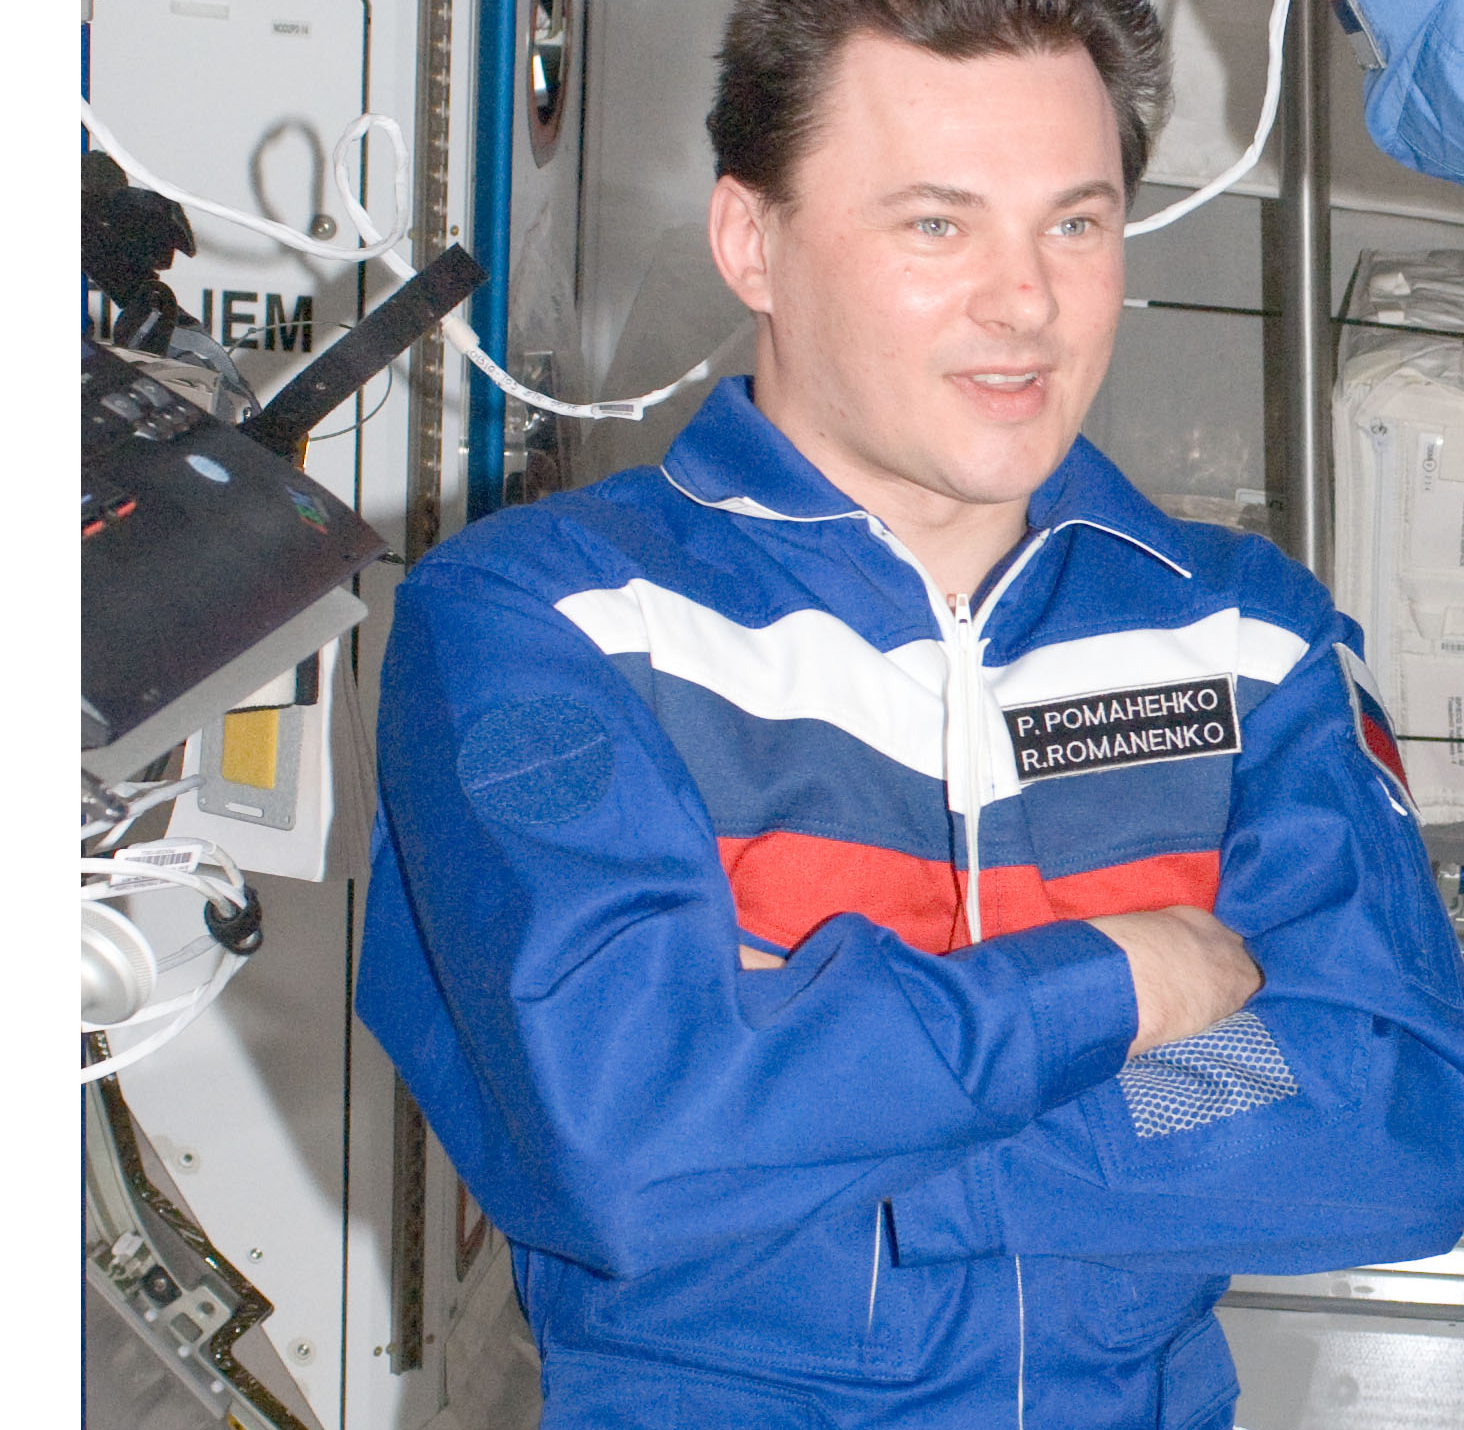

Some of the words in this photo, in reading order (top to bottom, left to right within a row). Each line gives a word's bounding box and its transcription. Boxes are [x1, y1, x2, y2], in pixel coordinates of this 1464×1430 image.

[1017, 715, 1041, 739] Р.
[1044, 688, 1219, 733] РОМАНЕНКО
[1021, 722, 1224, 771] R.ROMANENKO
